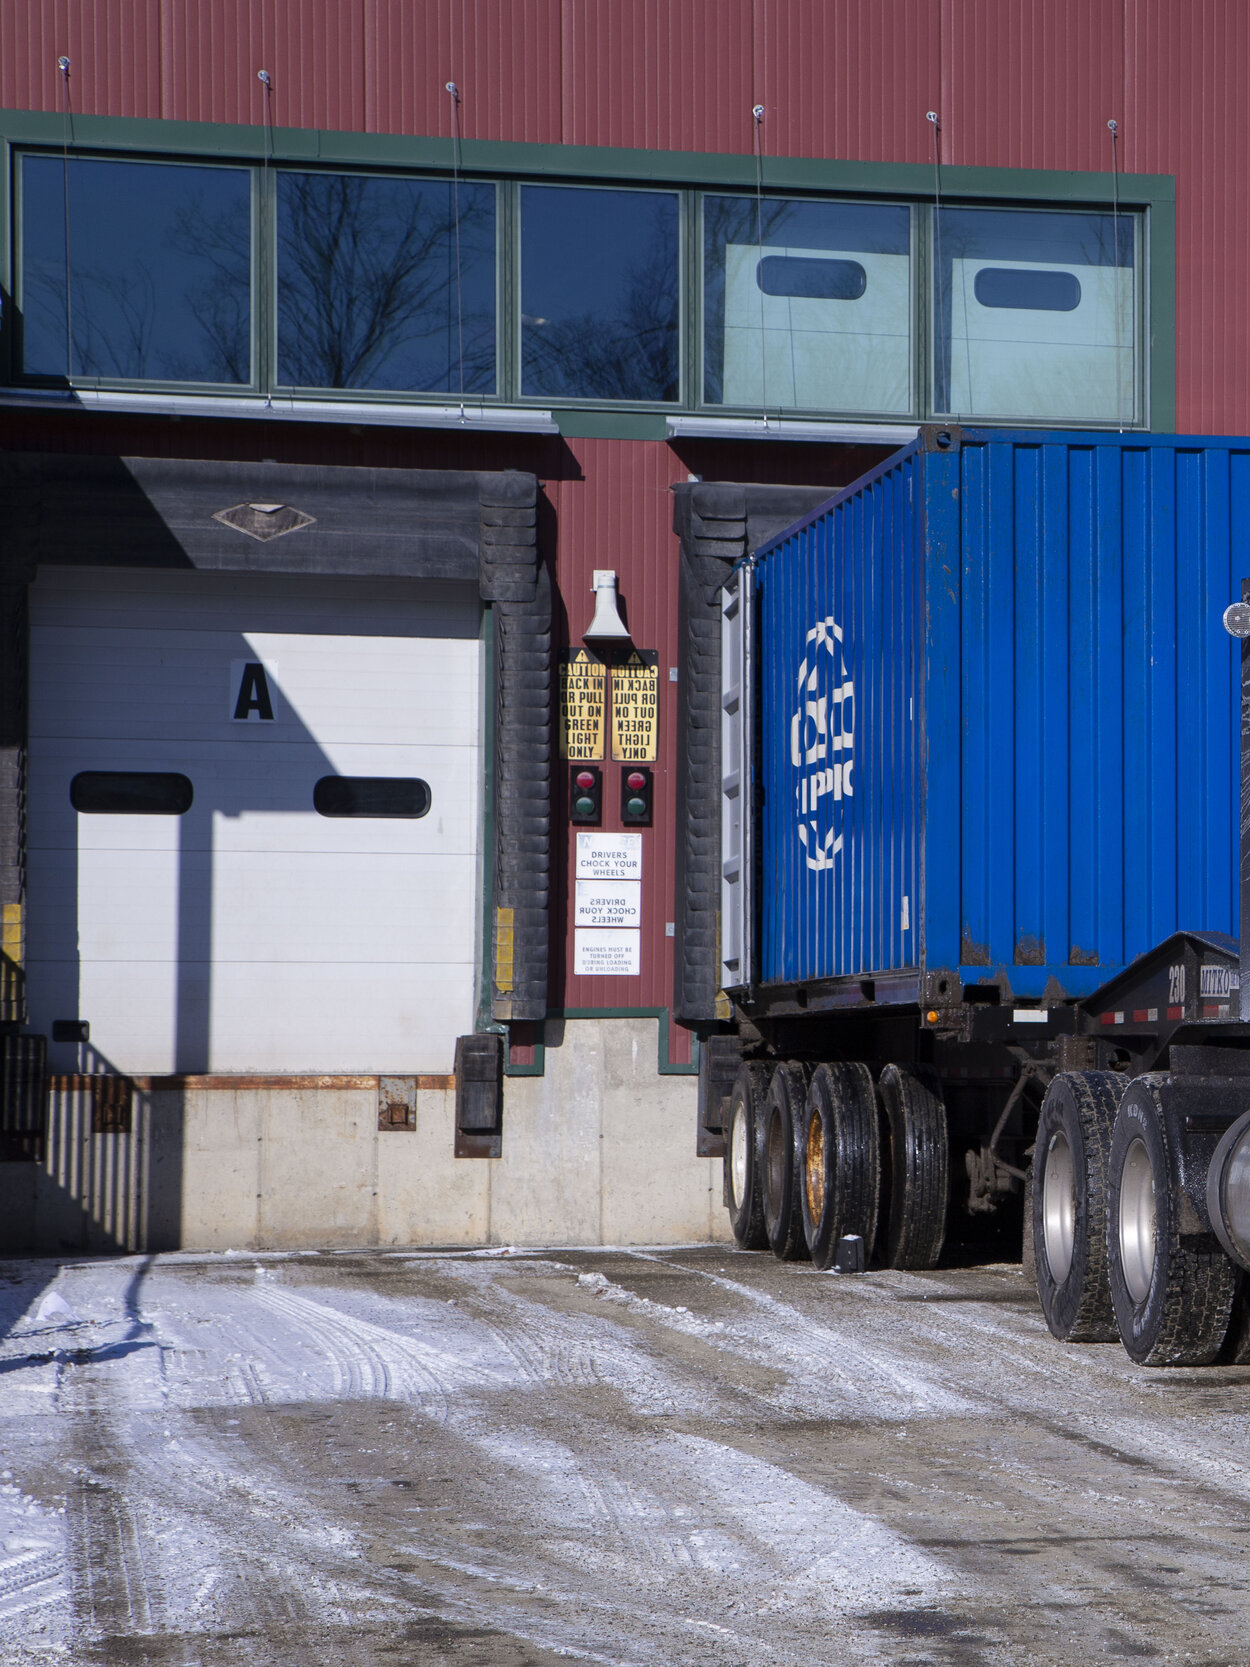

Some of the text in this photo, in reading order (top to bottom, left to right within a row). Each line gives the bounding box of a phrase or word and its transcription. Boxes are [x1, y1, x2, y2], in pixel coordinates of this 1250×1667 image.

[559, 663, 606, 676] CAUTION
[562, 678, 603, 690] BACK IN
[233, 663, 274, 720] A
[561, 692, 603, 703] OR PULL
[562, 705, 601, 717] OUT ON
[565, 719, 599, 730] GREEN
[566, 733, 598, 744] LIGHT
[569, 746, 594, 757] ONLY
[591, 851, 627, 859] DRIVERS
[614, 860, 638, 868] YOUR
[1169, 964, 1185, 1003] 230
